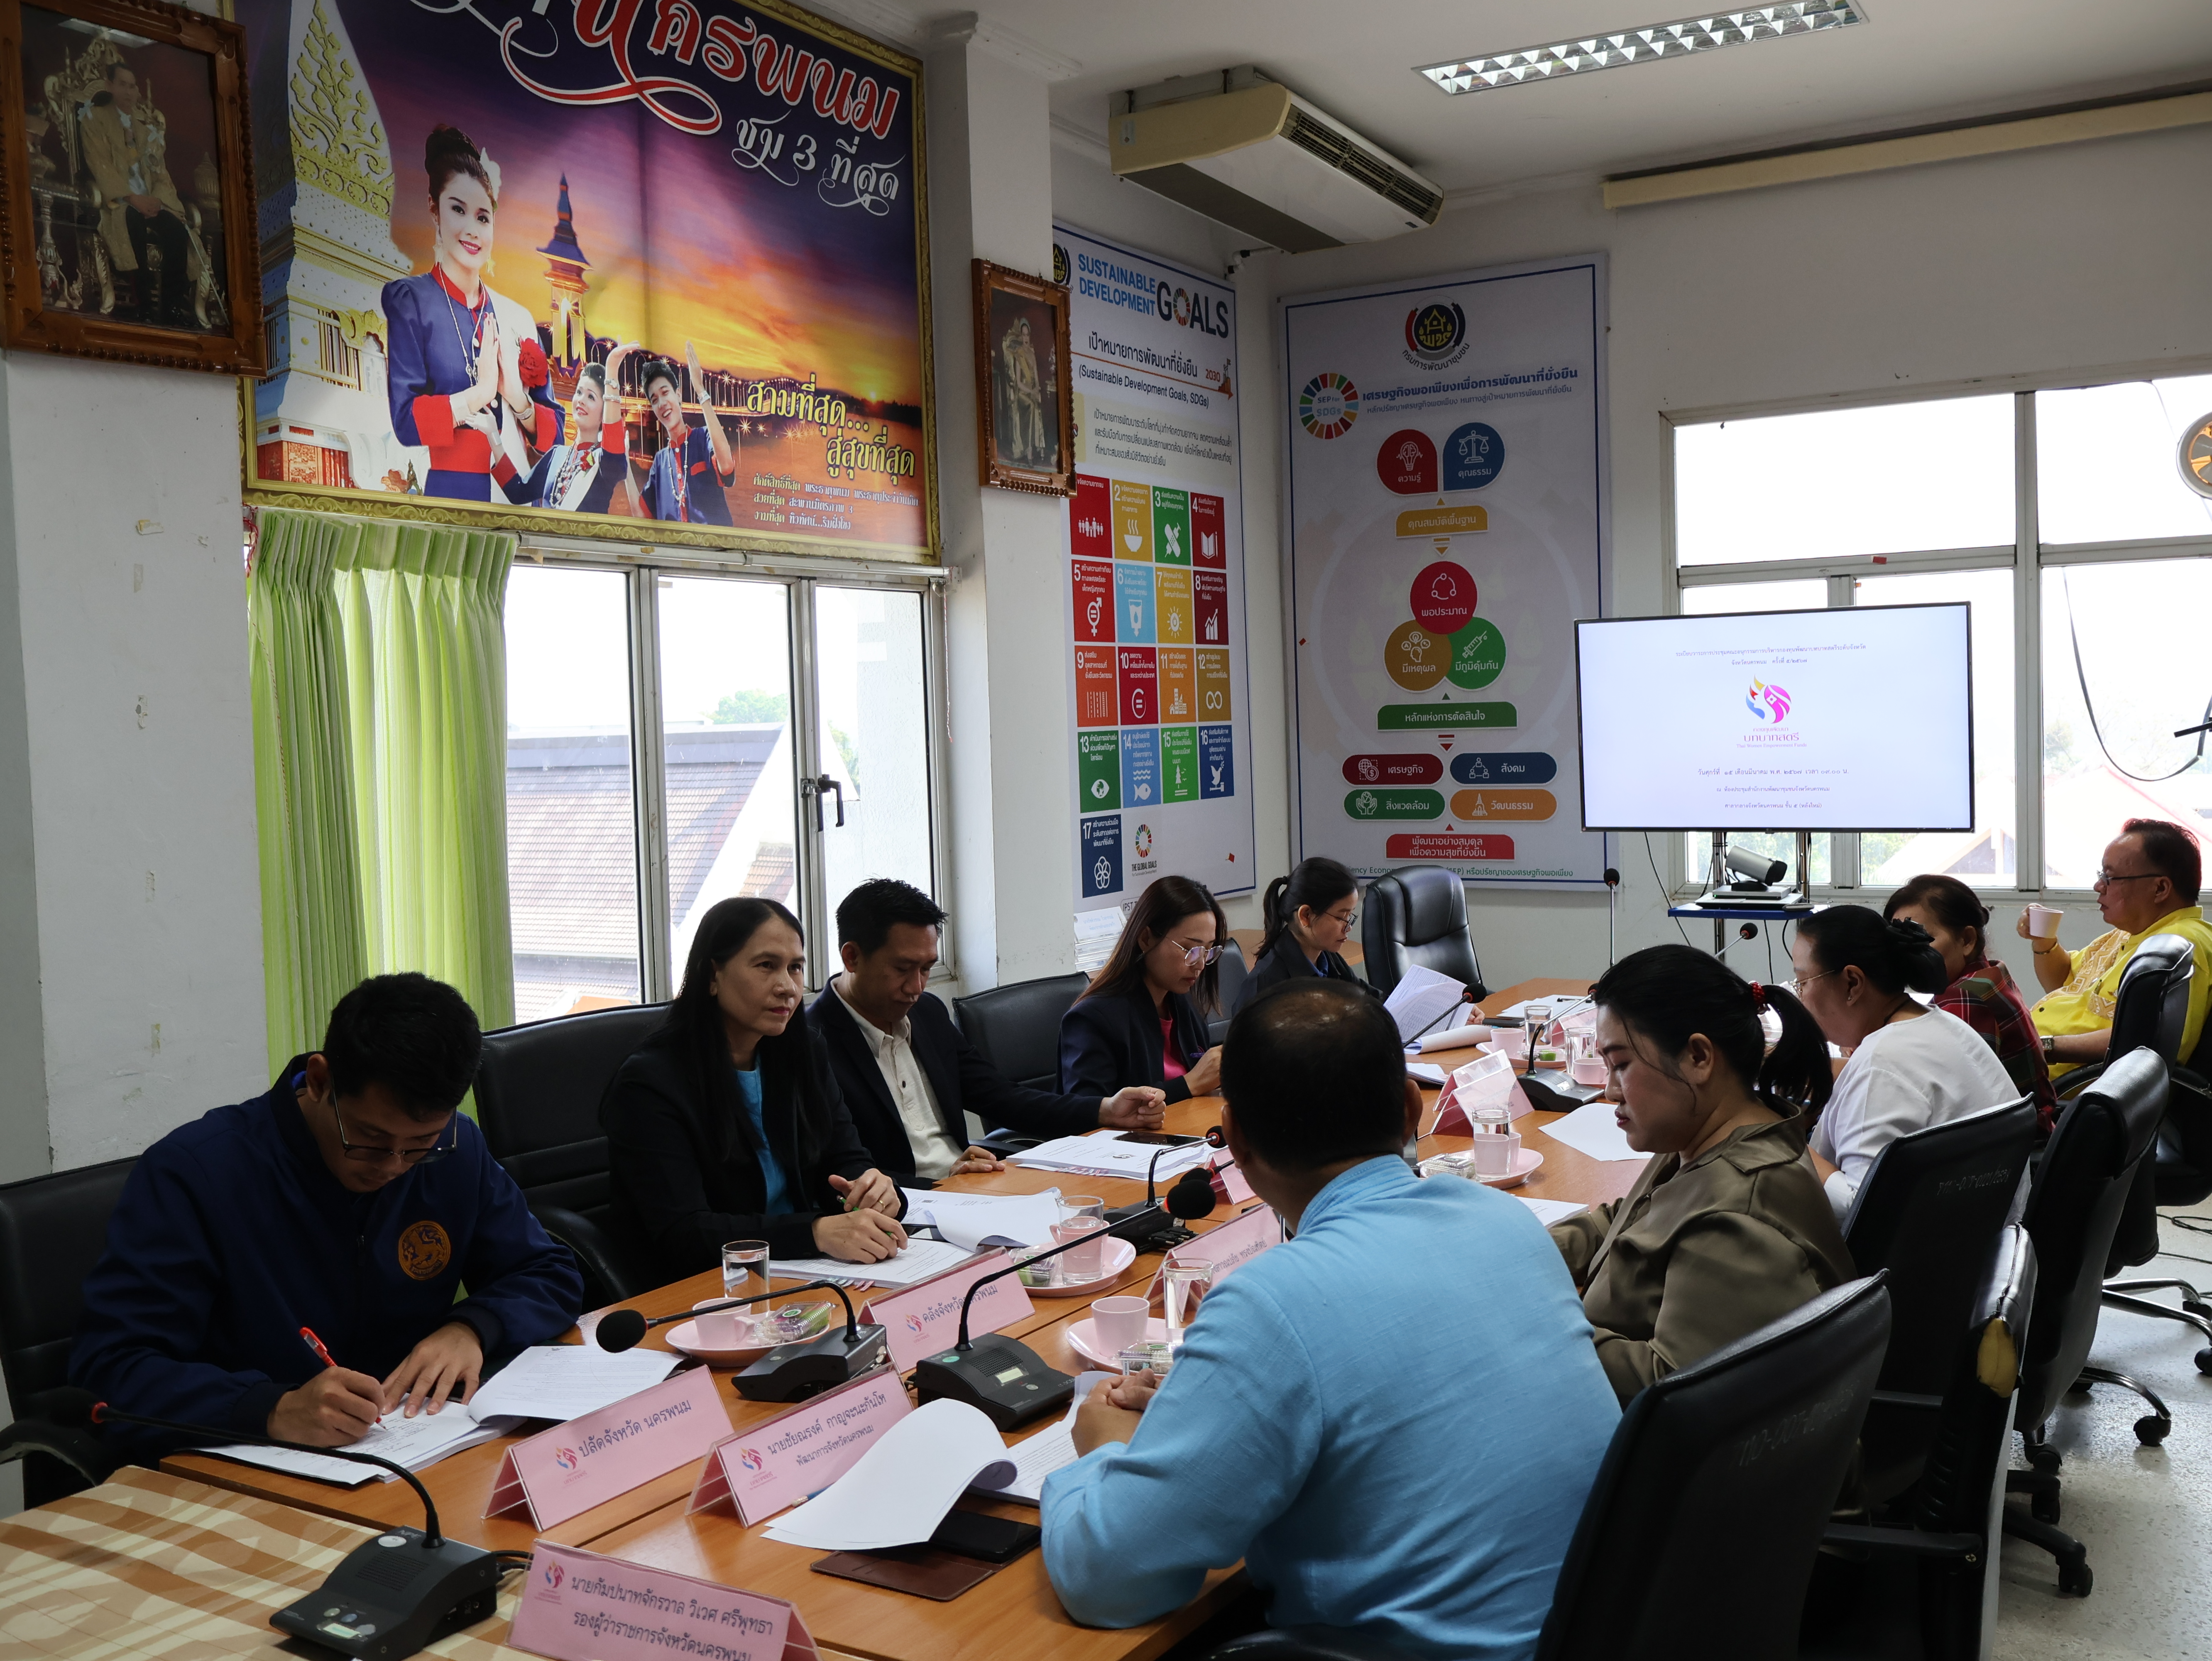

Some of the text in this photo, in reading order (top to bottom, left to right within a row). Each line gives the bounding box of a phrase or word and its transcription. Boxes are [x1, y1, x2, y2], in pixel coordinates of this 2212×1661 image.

[500, 0, 900, 140] นครพนม
[732, 109, 905, 216] ชม 3 ที่สุด
[1078, 253, 1156, 295] SUSTAINABLE
[1079, 277, 1155, 316] DEVELOPMENT
[1157, 281, 1229, 338] GOALS
[1088, 331, 1198, 378] เป้าหมายการพัฒนาที่ยั่งยืน
[1402, 343, 1470, 371] กรมการพัฒนาชุมชน
[1205, 369, 1221, 383] 2030
[1363, 366, 1578, 401] เศรษฐกิจพอเพียงเพื่อการพัฒนาที่ยั่งยืน
[1079, 364, 1209, 409] (Sustainable Development Goals, SDGs)
[747, 374, 869, 436] สามที่สุด...
[1316, 407, 1342, 417] SDGs
[827, 427, 914, 485] สู่สุขที่สุด
[1398, 472, 1422, 483] ความรู้
[1458, 467, 1492, 479] คุณธรรม
[805, 483, 850, 499] พระธาตุพนม
[854, 490, 918, 506] พระธาตุประจำวันเกิด
[1114, 484, 1121, 501] 2
[1155, 491, 1161, 507] 3
[754, 489, 853, 514] สวยที่สุด สะพานมิตรภาพ 3
[1192, 497, 1198, 513] 4
[754, 507, 785, 526] งามที่สุด
[1407, 514, 1476, 530] คุณสมบัติพื้นฐาน
[1074, 564, 1081, 581] 5
[1117, 568, 1124, 585] 6
[1157, 571, 1162, 587] 7
[1195, 575, 1201, 590] 8
[1422, 606, 1468, 617] พอประมาณ
[1077, 651, 1084, 669] 9
[1120, 652, 1129, 669] 10
[1160, 653, 1167, 669] 11
[1198, 654, 1206, 669] 12
[1455, 661, 1499, 673] มีภูมิคุ้มกัน
[1402, 663, 1436, 675] มีเหตุผล
[1405, 710, 1486, 723] หลักแห่งการตัดสินใจ
[1080, 735, 1089, 753] 13
[1123, 733, 1132, 750] 14
[1162, 731, 1171, 747] 15
[1200, 729, 1208, 745] 16
[1744, 732, 1799, 742] บทบาทสตรี
[1387, 764, 1424, 776] เศรษฐกิจ
[1501, 763, 1525, 773] สังคม
[1698, 767, 1720, 777] วันศุกร์ที่
[1385, 798, 1429, 811] สิ่งแวดล้อม
[1491, 799, 1534, 811] วัฒนธรรม
[1083, 822, 1092, 840] 17
[1412, 835, 1483, 848] พัฒนาอย่างสมดุล
[1409, 846, 1486, 859] เพื่อความสุขที่ยั่งยืน
[1137, 862, 1148, 871] GLOBAL
[1148, 860, 1157, 869] GOALS
[1466, 867, 1573, 877] หรือปรัชญาของเศรษฐกิจพอเพียง
[1123, 902, 1133, 911] IPST
[923, 1284, 998, 1323] คลังจังหวัดครพนม
[579, 1399, 692, 1458] ปลัดจังหวัด นครพนม
[768, 1418, 823, 1455] นายชัยณรงค์
[796, 1424, 874, 1466] พัฒนาการจังหวัดนครพนม
[571, 1575, 685, 1615] นายกัมปนาทจักรวาล
[721, 1609, 773, 1637] ศรีพุทธา
[573, 1610, 751, 1661] รองผู้ว่าราชการจังหวัดนครพนม
